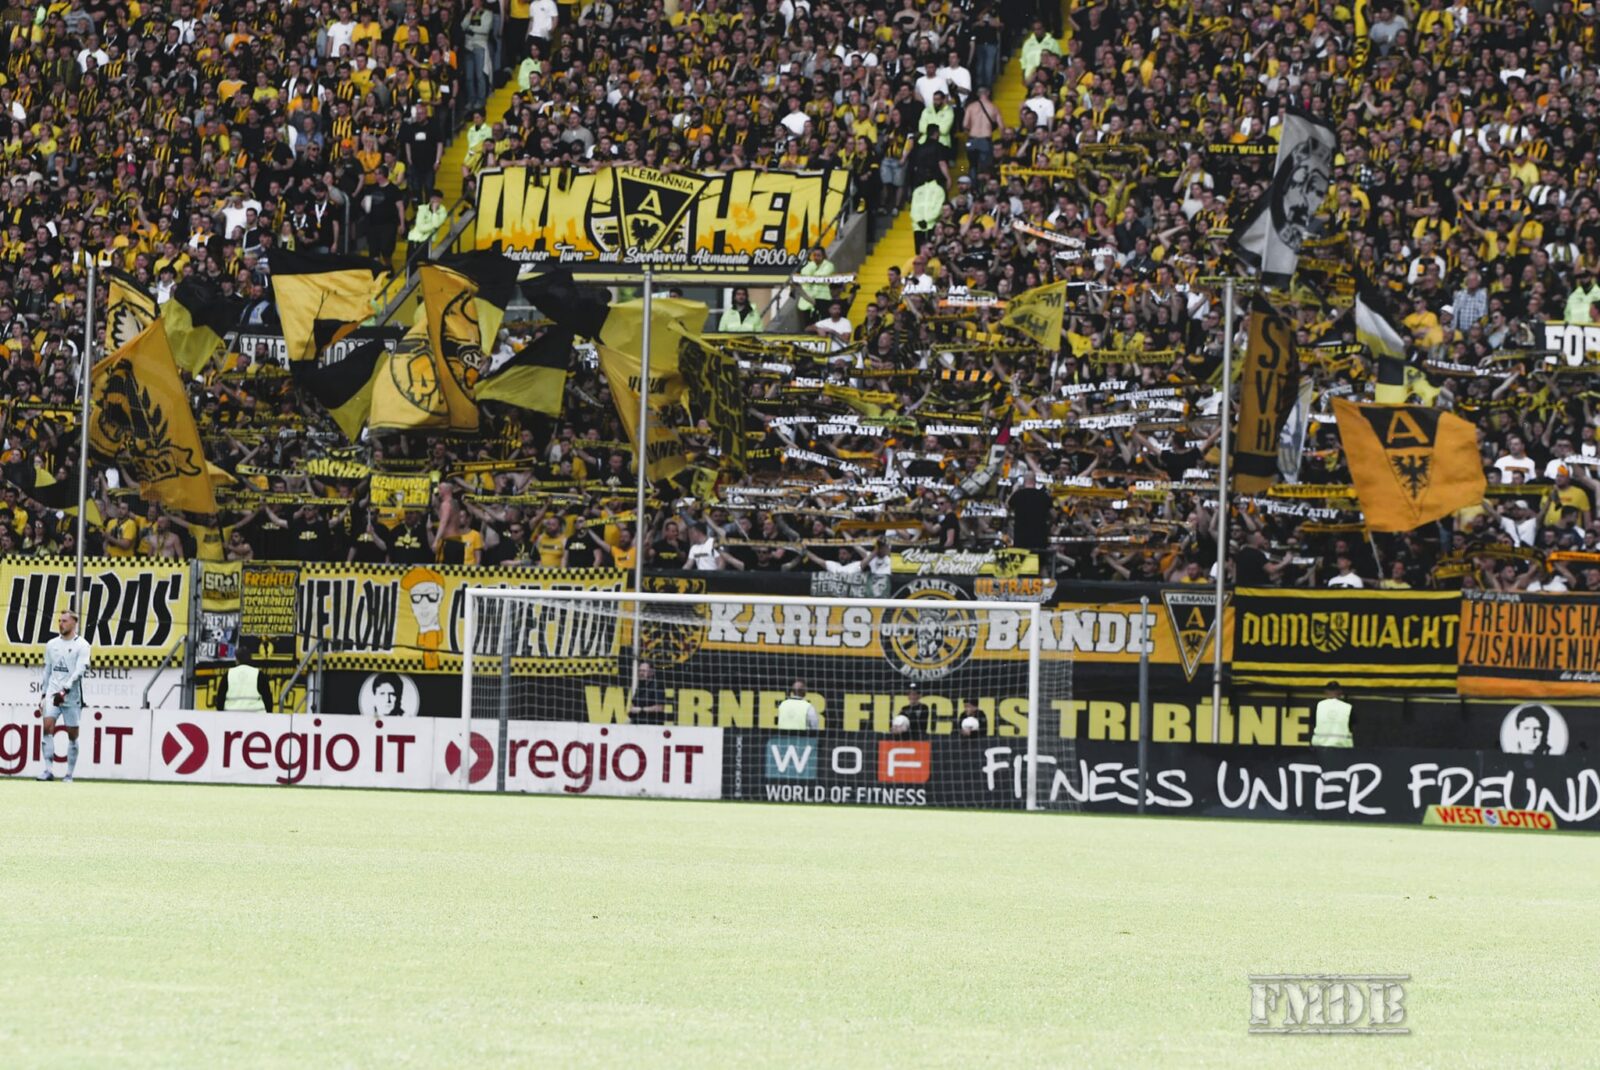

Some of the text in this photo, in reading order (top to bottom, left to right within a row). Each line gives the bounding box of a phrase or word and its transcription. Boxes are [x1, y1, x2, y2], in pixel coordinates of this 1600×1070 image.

[1237, 144, 1265, 155] WILL
[621, 165, 695, 192] ALEMANNIA
[637, 188, 663, 216] A
[502, 245, 549, 263] Aachener
[554, 243, 594, 264] Turn-
[599, 249, 620, 264] und
[623, 246, 688, 265] Sportverein
[691, 248, 749, 266] Alemannia
[753, 247, 785, 266] 1900
[1061, 379, 1128, 397] FORZA ATSV
[818, 424, 885, 437] FORZA ATSV
[1385, 409, 1429, 445] A
[244, 570, 296, 587] FREIHEIT
[908, 577, 958, 595] KARLS
[974, 577, 1042, 595] ULTRAS
[6, 571, 183, 647] ULTRAS
[299, 578, 398, 652] YELLOW
[1185, 606, 1206, 628] A
[708, 602, 1156, 653] KARLS BANDE
[1242, 611, 1461, 650] DOM WACHT
[83, 669, 132, 680] ESTELLT.
[93, 711, 134, 765] iT
[223, 718, 416, 784] regio iT
[509, 728, 648, 793] regio
[662, 729, 704, 784] iT
[765, 784, 927, 806] WORLD OF FITNESS
[1217, 761, 1386, 815] UNTER
[1435, 807, 1552, 830] WEST LOTTO
